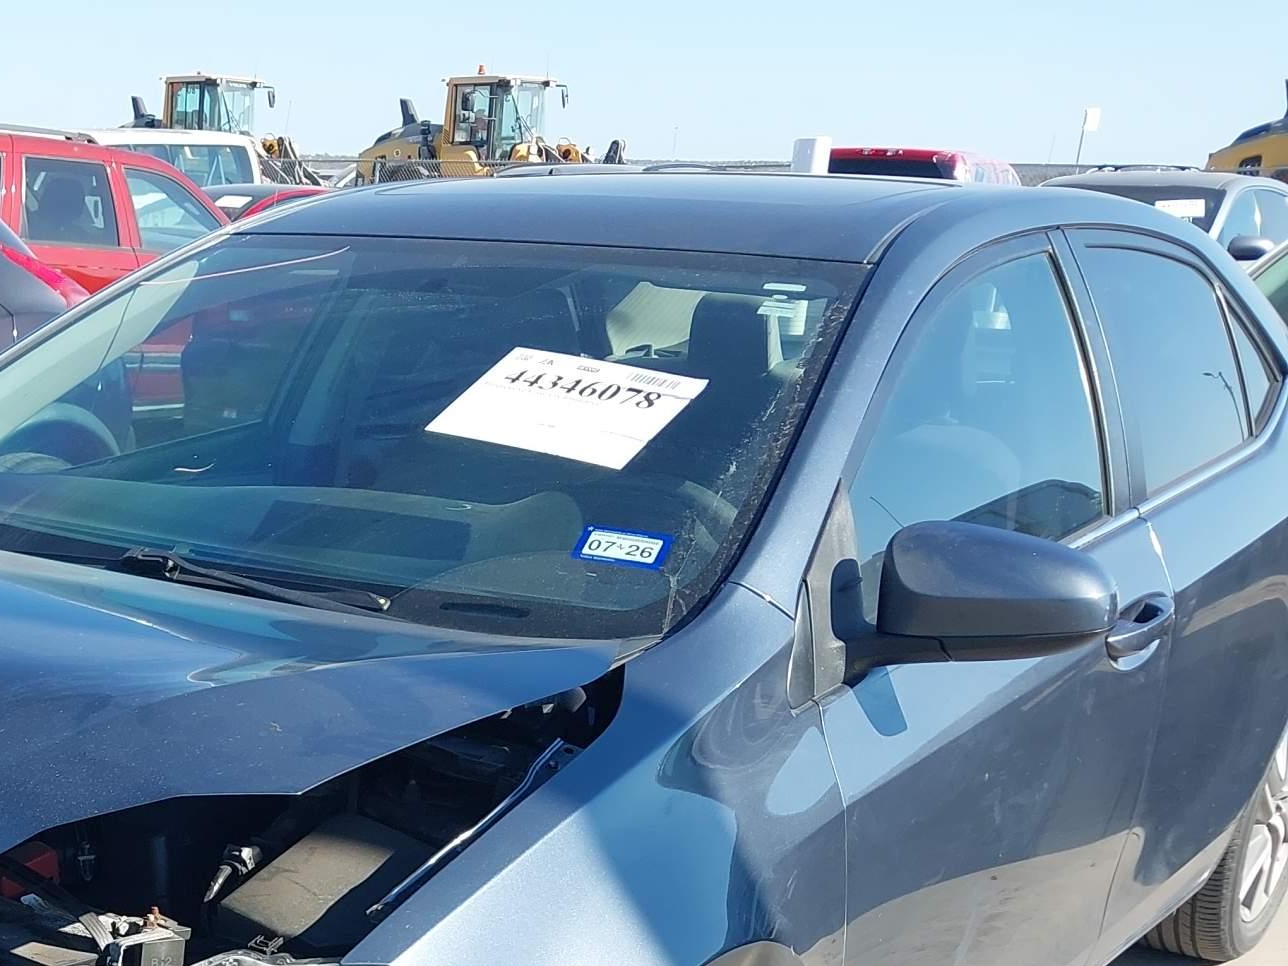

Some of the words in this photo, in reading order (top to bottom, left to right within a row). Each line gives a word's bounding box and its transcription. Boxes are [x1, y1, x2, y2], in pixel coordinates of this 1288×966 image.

[503, 368, 663, 409] 44346078
[587, 539, 617, 552] 07
[624, 544, 655, 559] 26
